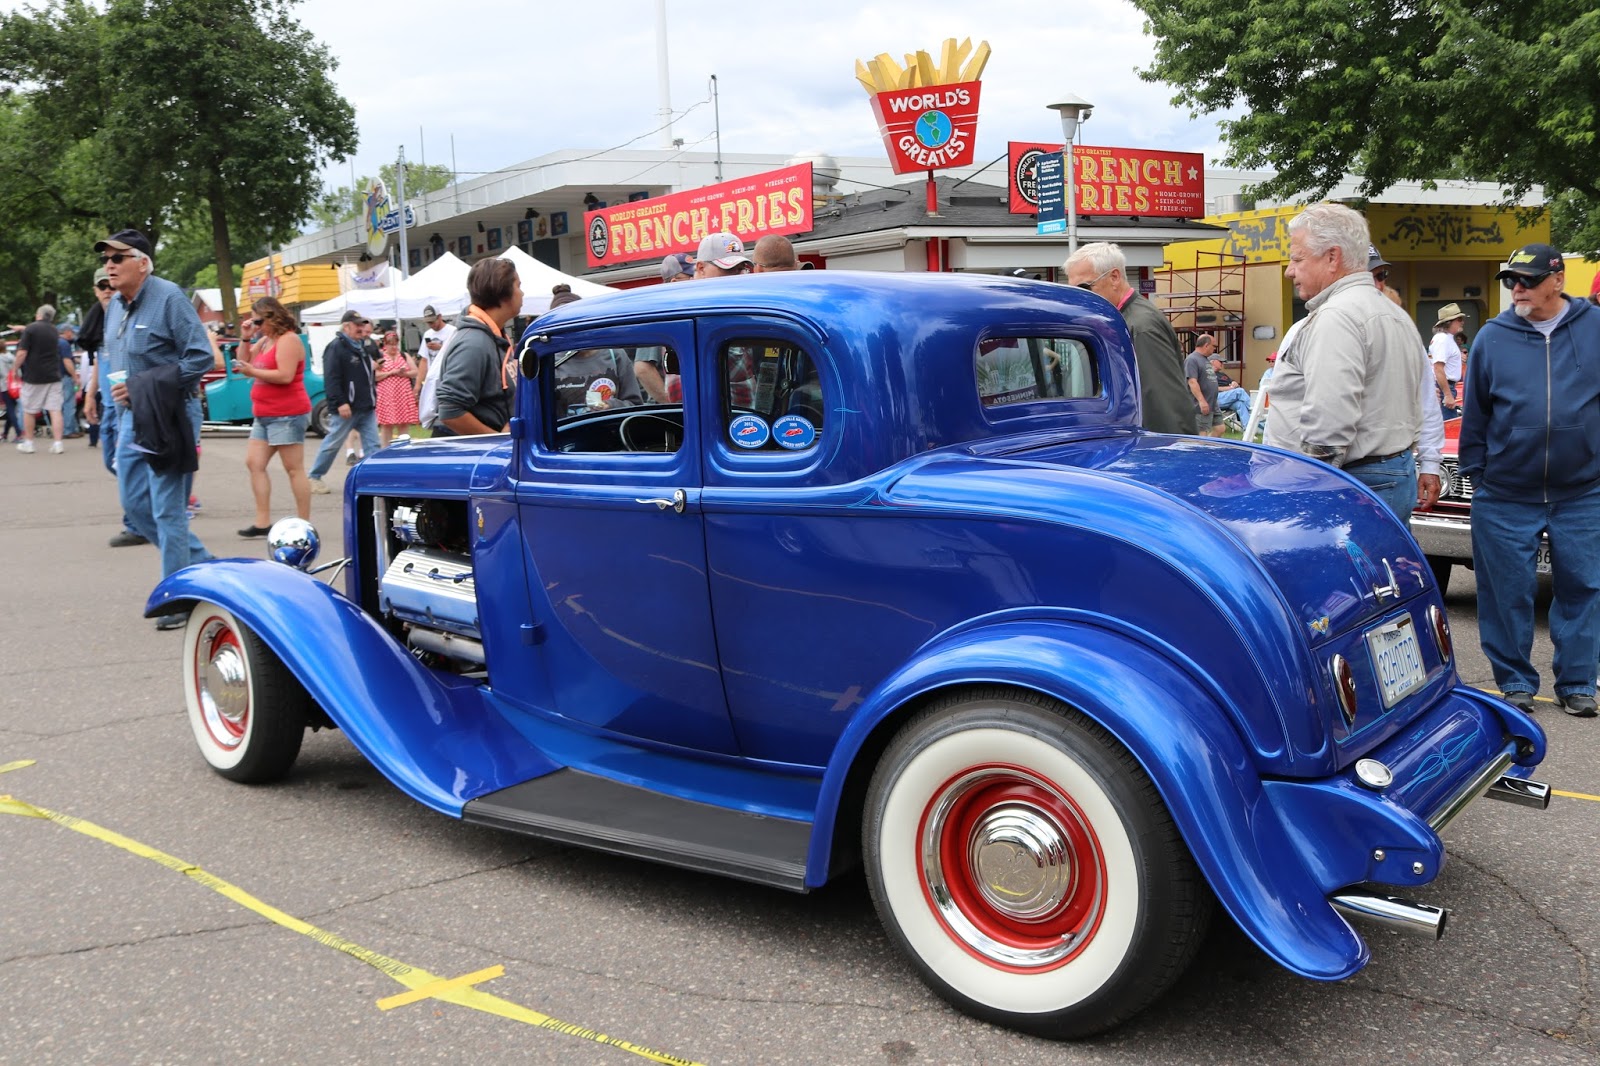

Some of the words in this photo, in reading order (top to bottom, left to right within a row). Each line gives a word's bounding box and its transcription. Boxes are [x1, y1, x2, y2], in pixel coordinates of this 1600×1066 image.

[889, 89, 971, 113] WORLD'S
[898, 128, 969, 166] GREATEST
[1086, 148, 1112, 156] GREATEST
[1020, 155, 1036, 179] WORLD'S
[1159, 191, 1202, 199] HOME-GROWN!
[609, 210, 635, 222] WORLD'S
[636, 203, 668, 217] GREATEST
[610, 207, 710, 256] FRENCH
[720, 187, 804, 236] FRIES
